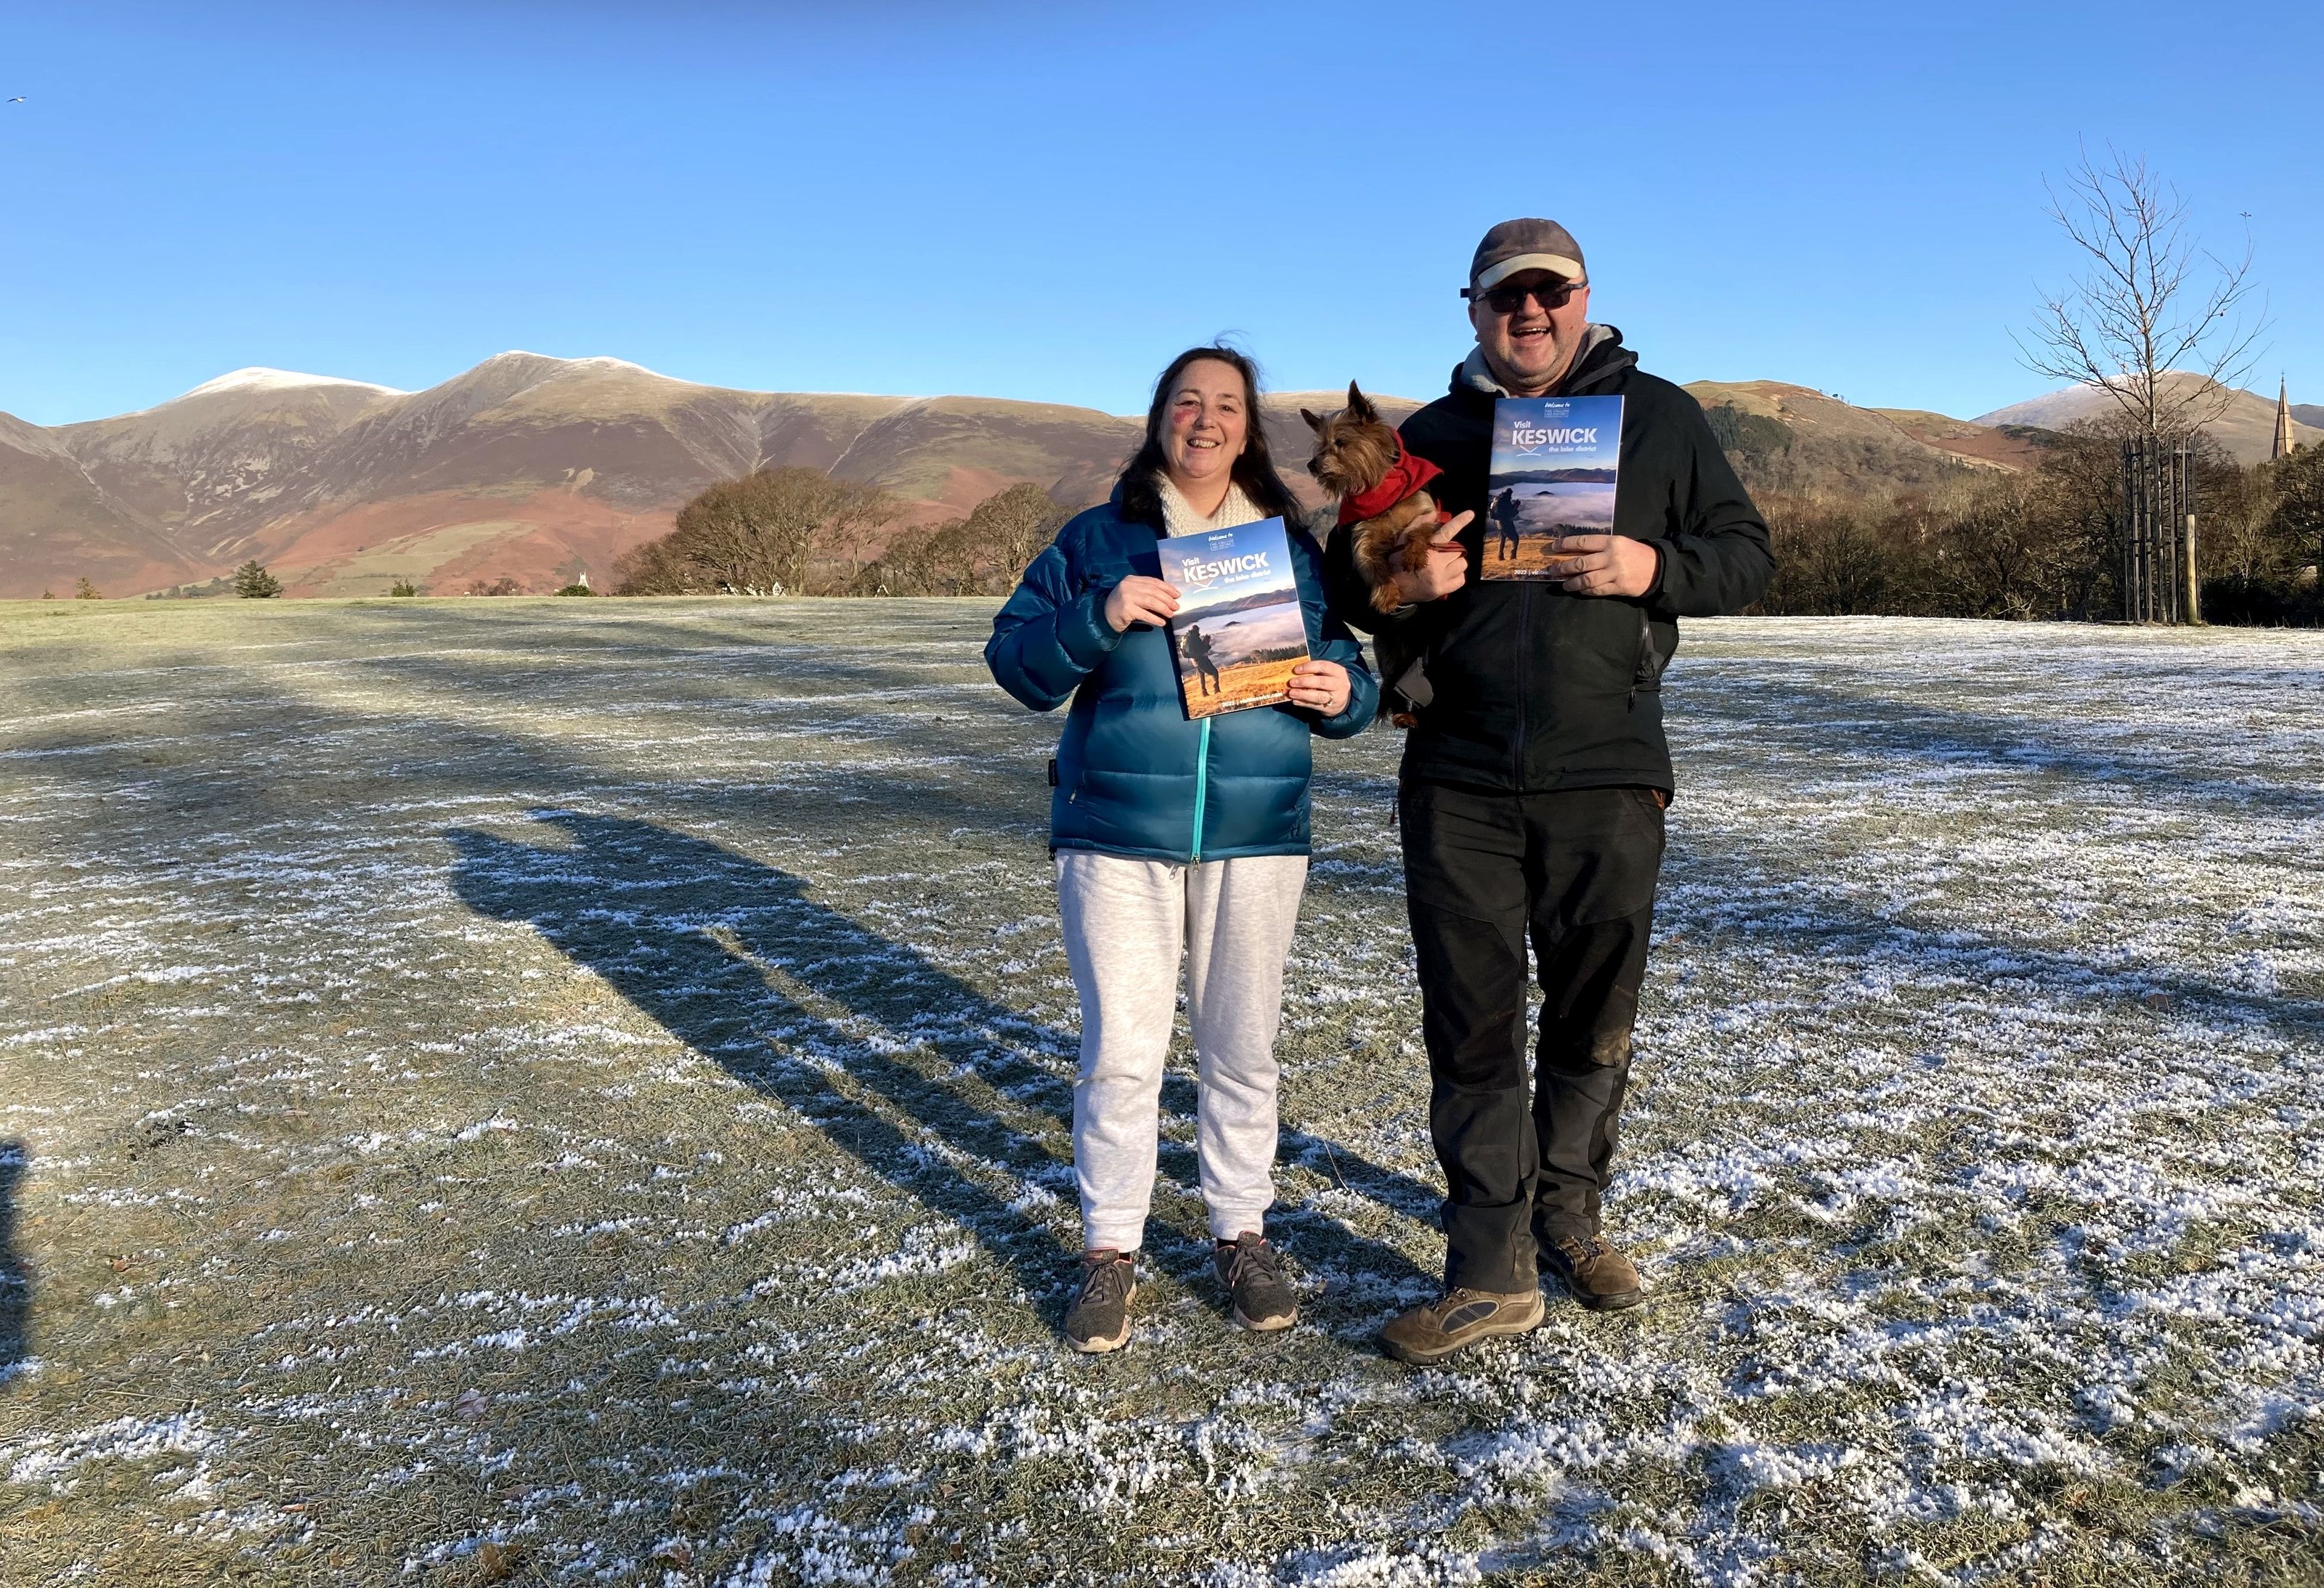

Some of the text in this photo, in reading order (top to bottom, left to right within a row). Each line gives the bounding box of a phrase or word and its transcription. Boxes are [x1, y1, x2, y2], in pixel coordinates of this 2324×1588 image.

[1511, 428, 1598, 445] KESWICK
[1182, 557, 1200, 566] Visit
[1183, 552, 1269, 583] KESWICK
[1250, 569, 1272, 578] district
